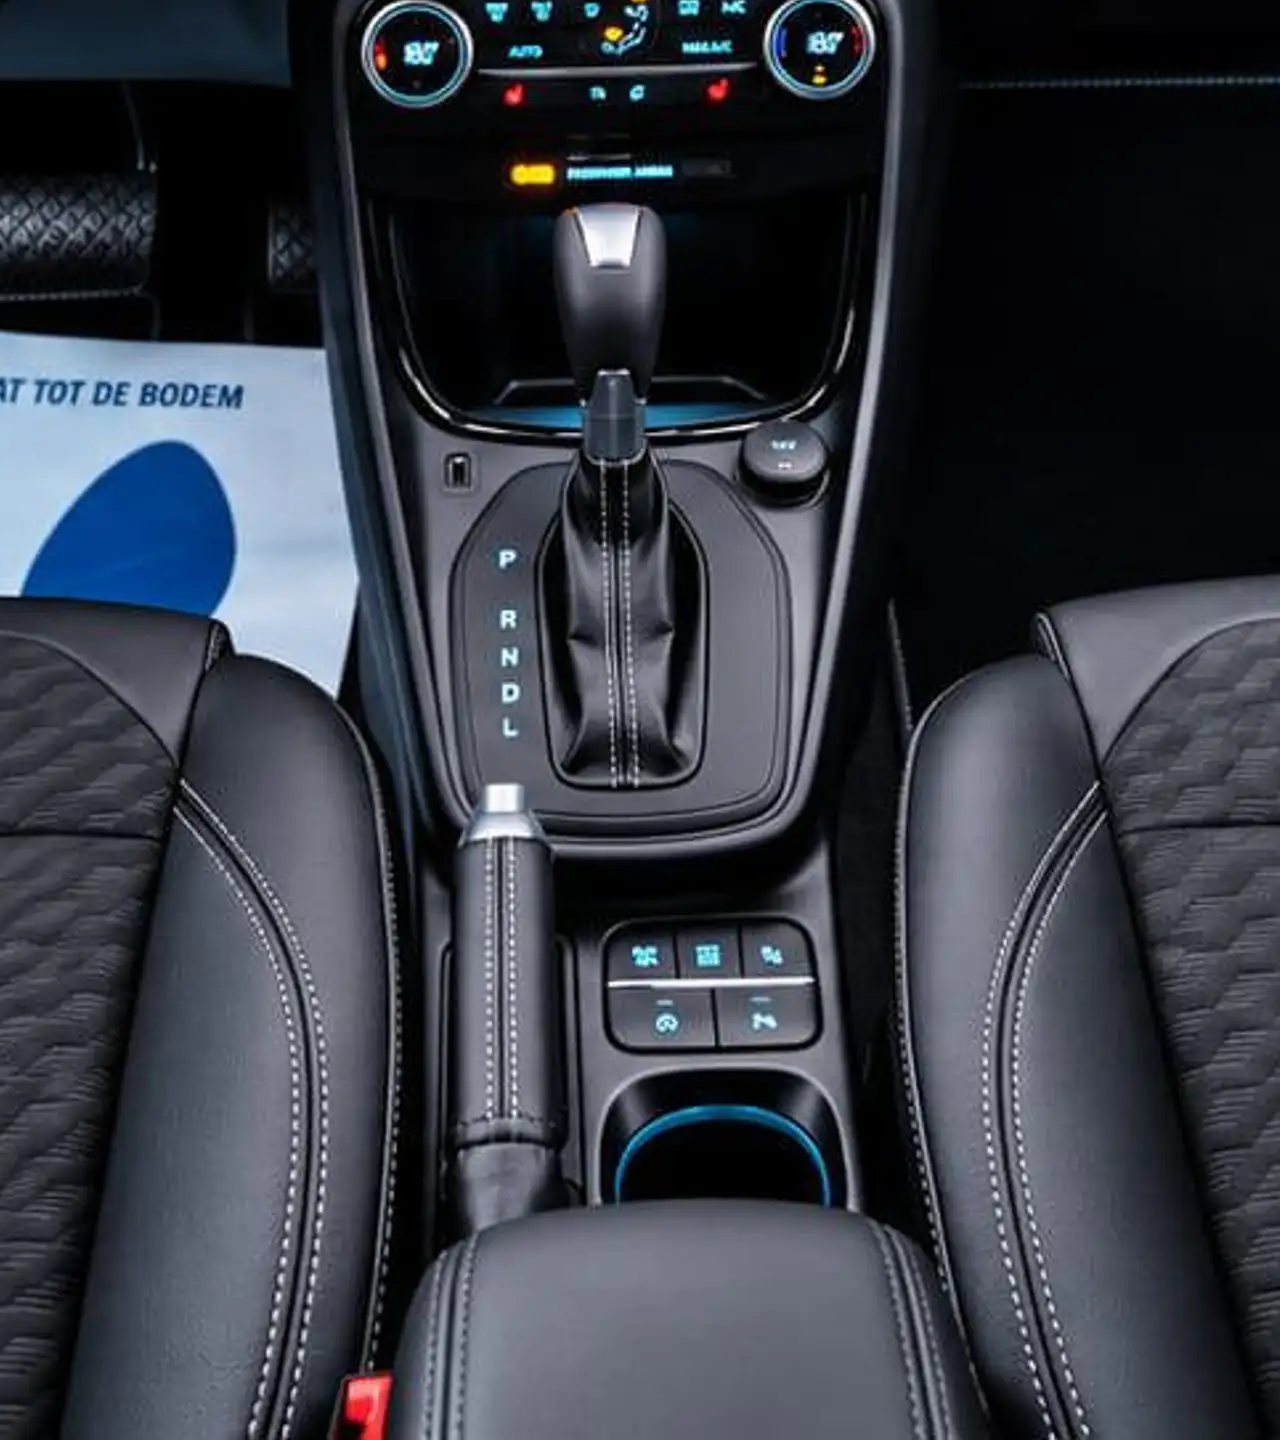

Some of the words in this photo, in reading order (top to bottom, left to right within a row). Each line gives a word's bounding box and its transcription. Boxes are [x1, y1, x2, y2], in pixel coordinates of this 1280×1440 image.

[34, 378, 86, 406] TOT
[92, 381, 132, 407] DE
[138, 381, 245, 410] BODEM
[498, 549, 518, 570] P
[499, 609, 518, 630] R
[501, 646, 520, 668] N
[501, 682, 521, 705] D
[501, 716, 520, 738] L
